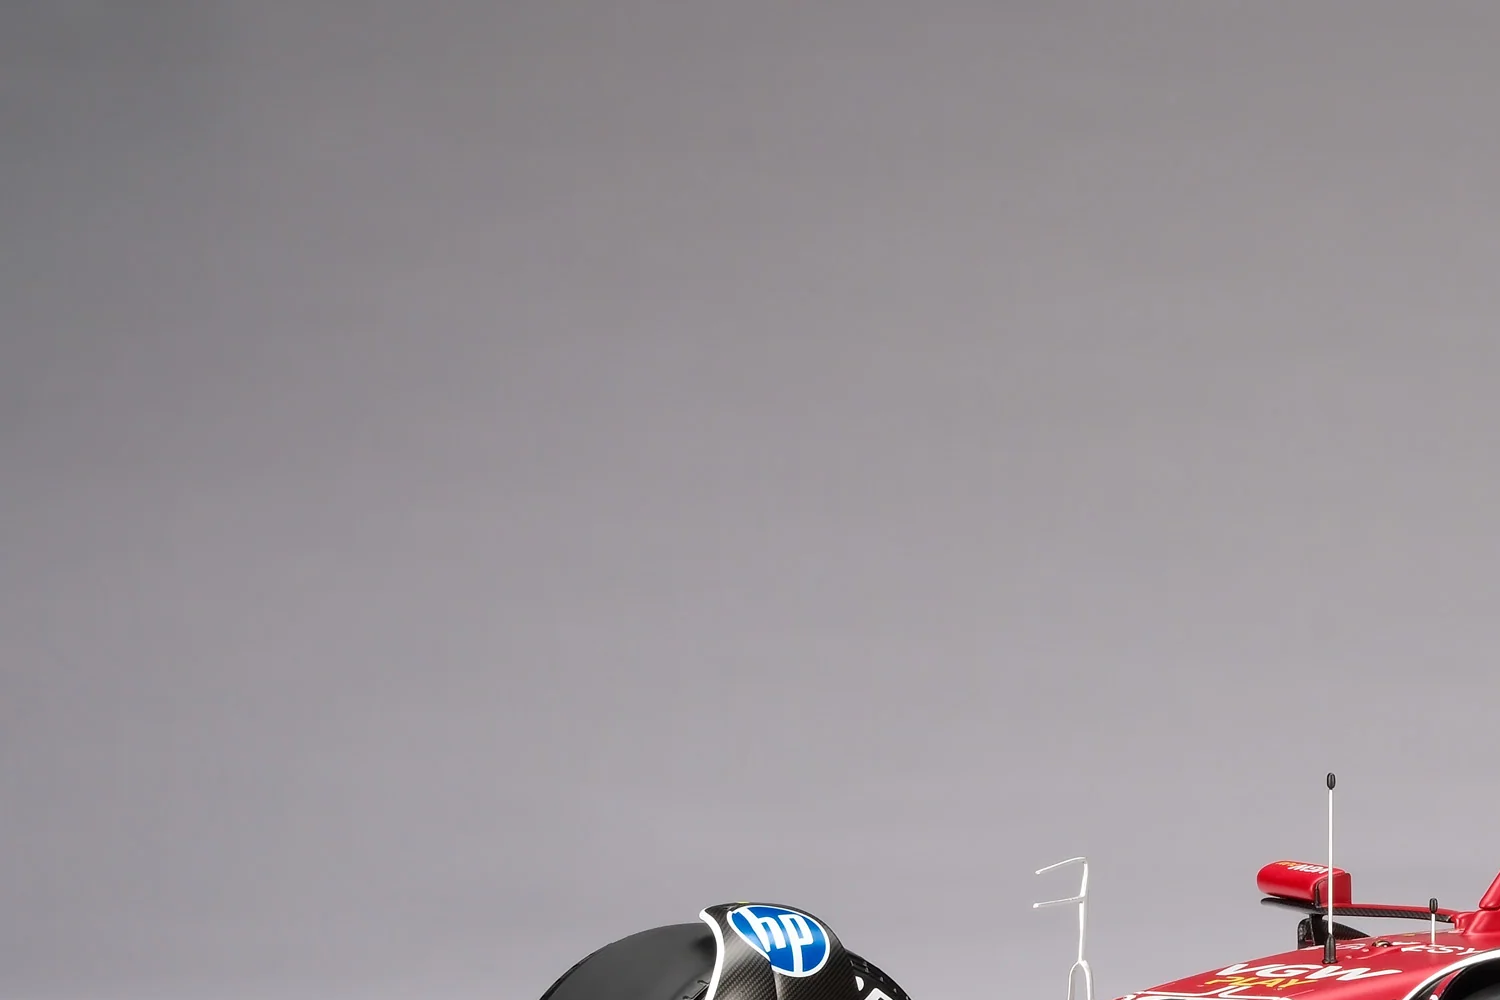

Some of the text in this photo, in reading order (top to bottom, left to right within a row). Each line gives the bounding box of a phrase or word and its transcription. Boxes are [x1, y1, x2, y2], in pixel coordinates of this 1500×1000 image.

[737, 906, 814, 976] hp
[1216, 963, 1402, 981] VGW
[1205, 976, 1318, 988] PLAY
